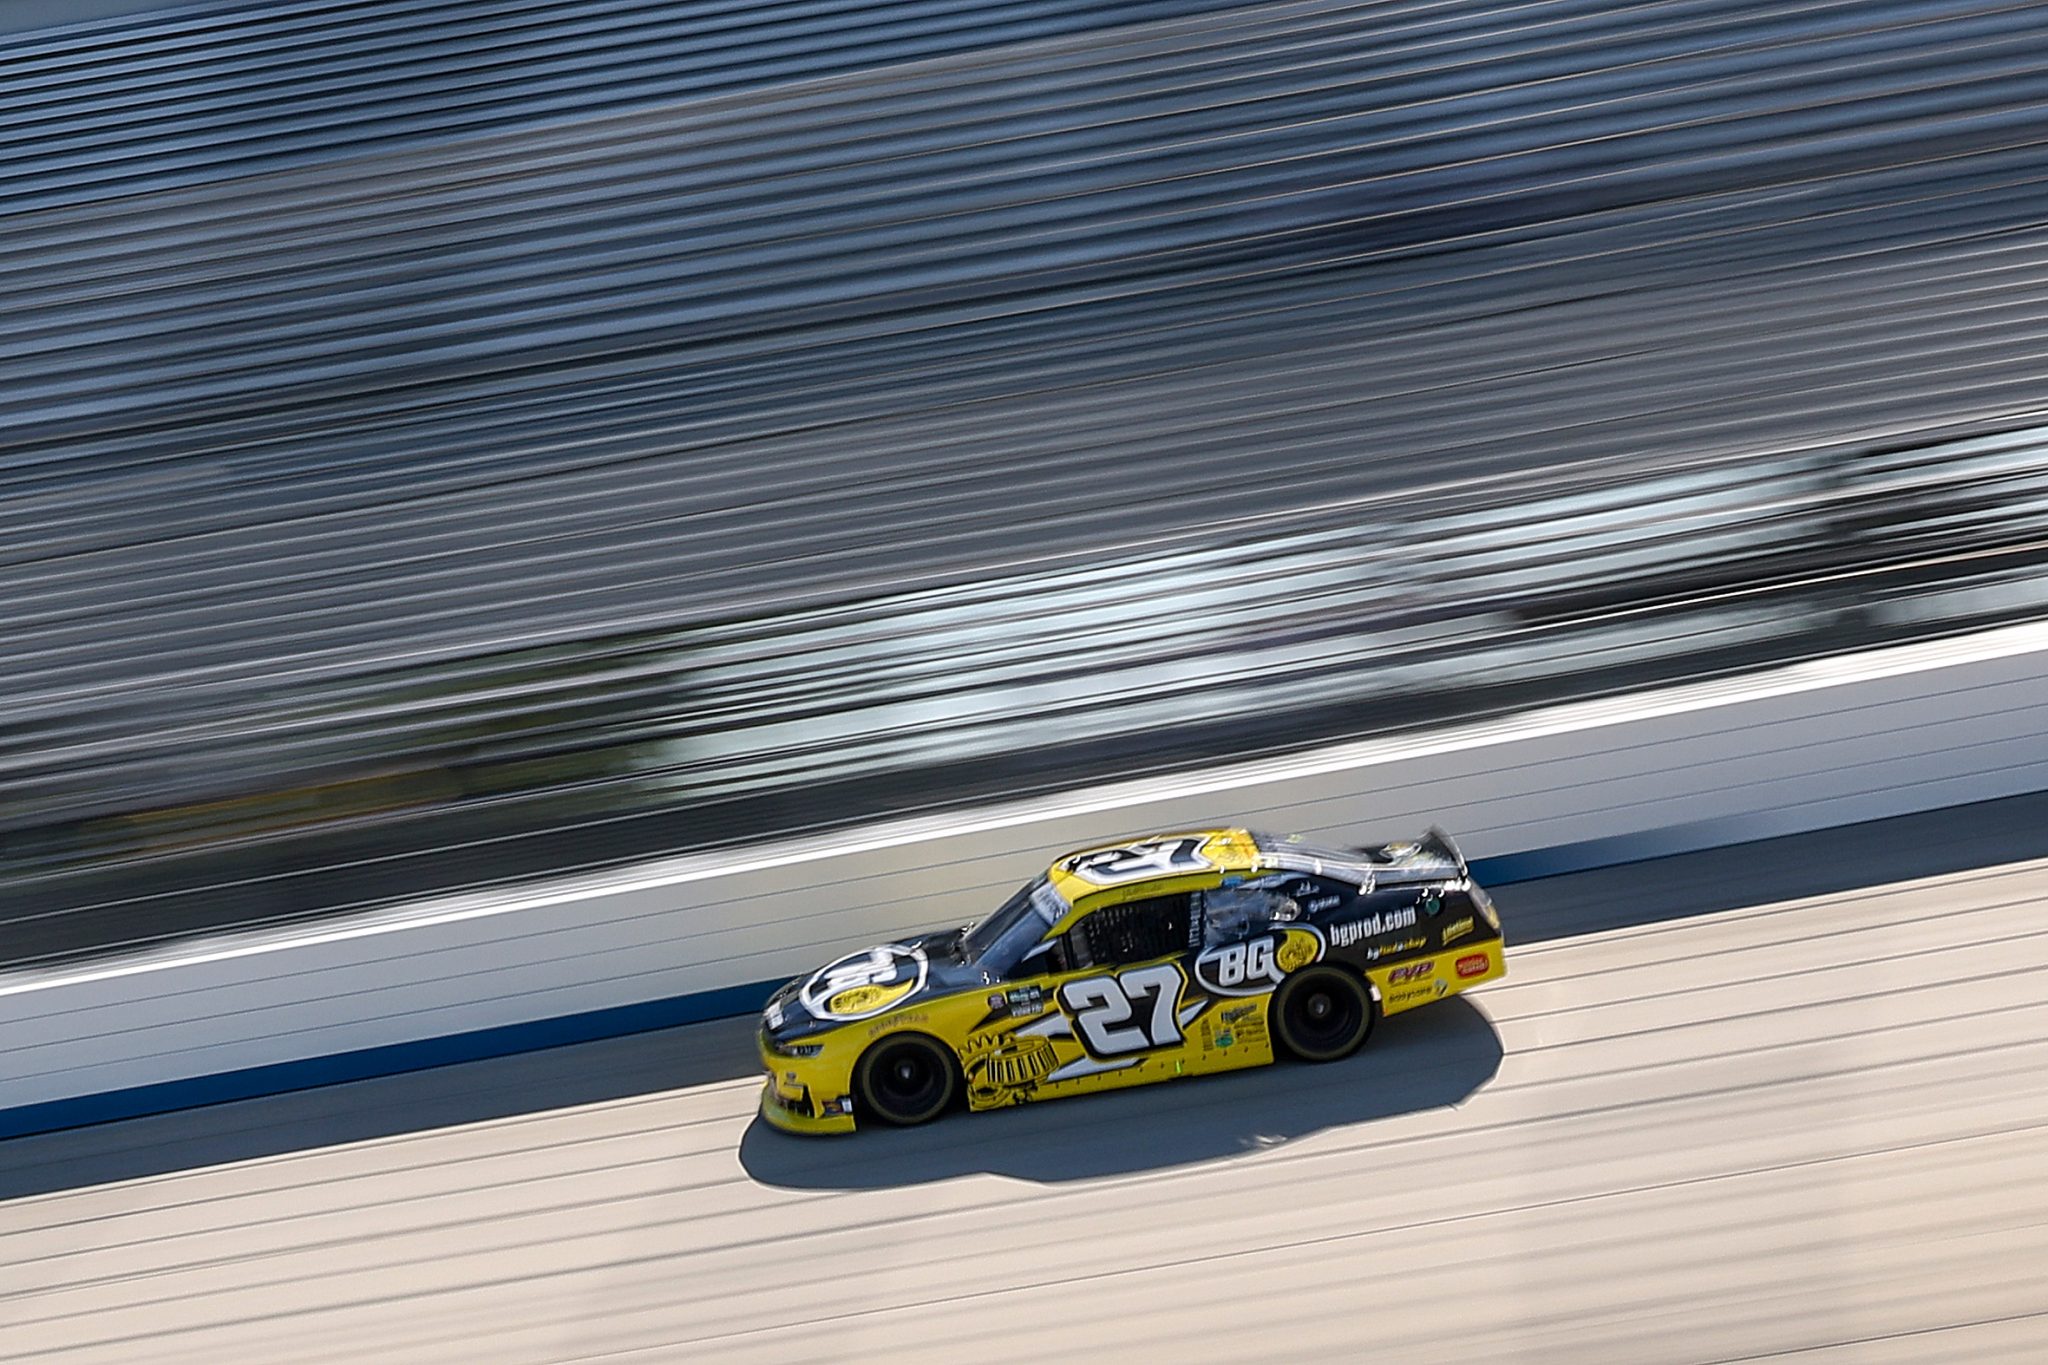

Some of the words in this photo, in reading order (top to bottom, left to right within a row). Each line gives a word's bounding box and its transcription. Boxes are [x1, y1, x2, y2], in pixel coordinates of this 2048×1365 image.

[1330, 905, 1417, 947] bgprod.com
[1218, 934, 1279, 987] BG
[1061, 962, 1183, 1055] 27
